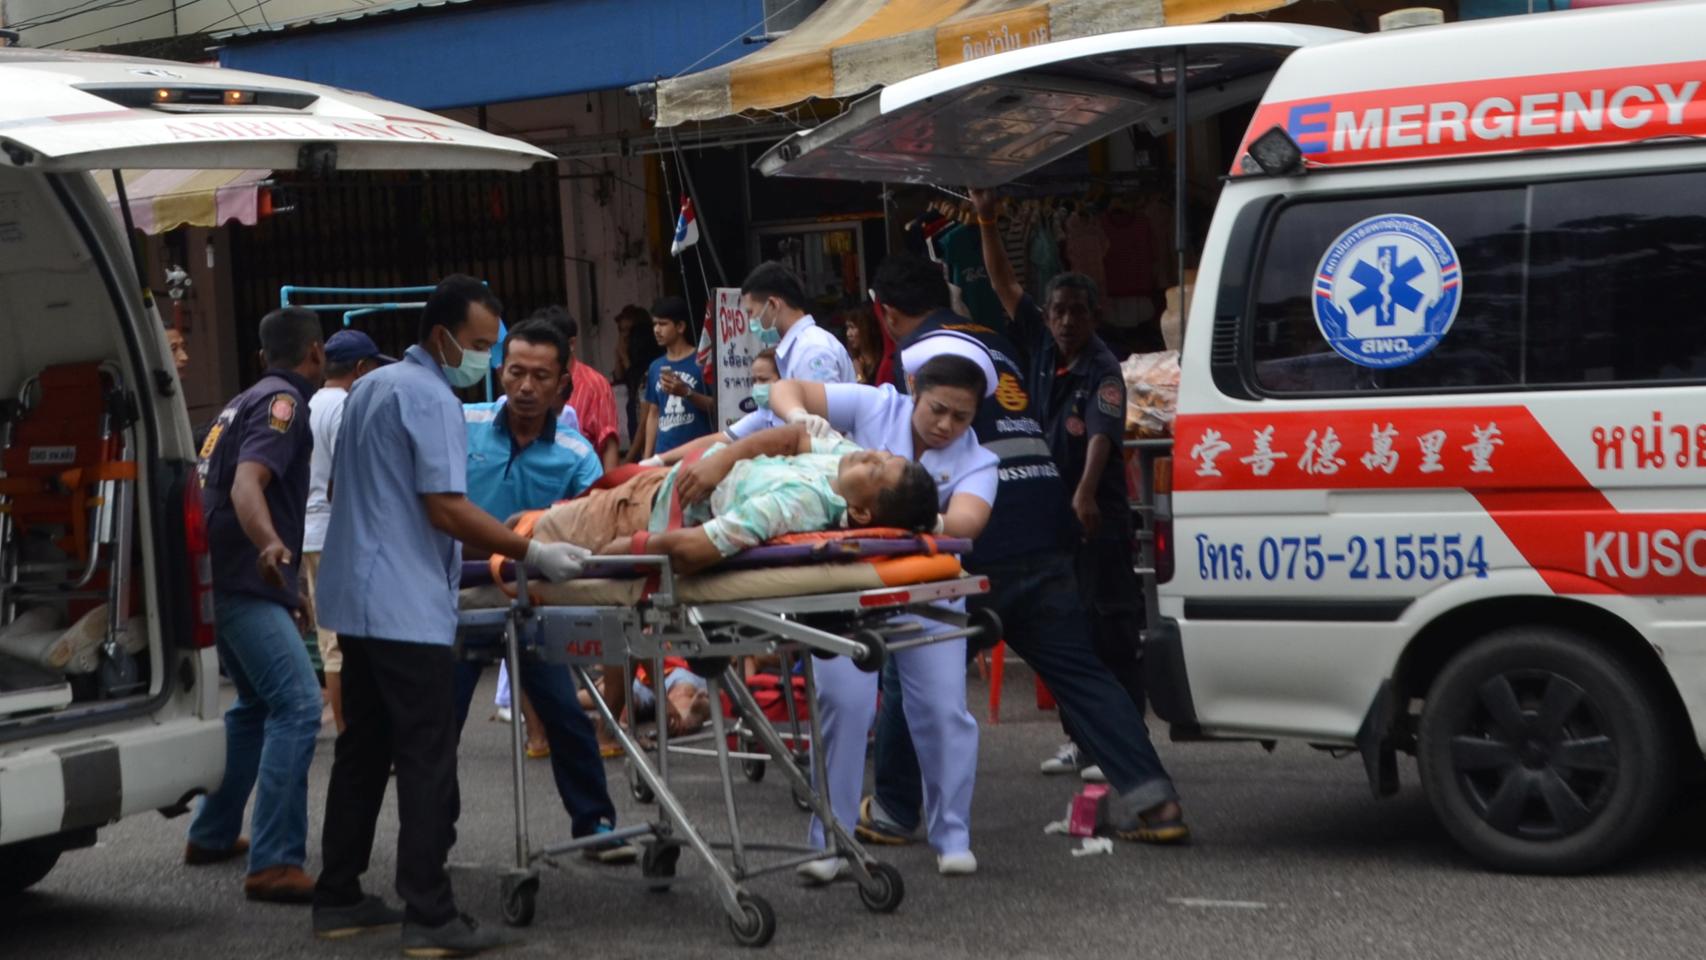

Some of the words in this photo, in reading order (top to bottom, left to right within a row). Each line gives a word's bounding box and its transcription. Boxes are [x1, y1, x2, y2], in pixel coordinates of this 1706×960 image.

[165, 121, 455, 141] AMBULANCE
[1286, 80, 1702, 154] EMERGENCY
[1258, 533, 1489, 581] 075-215554
